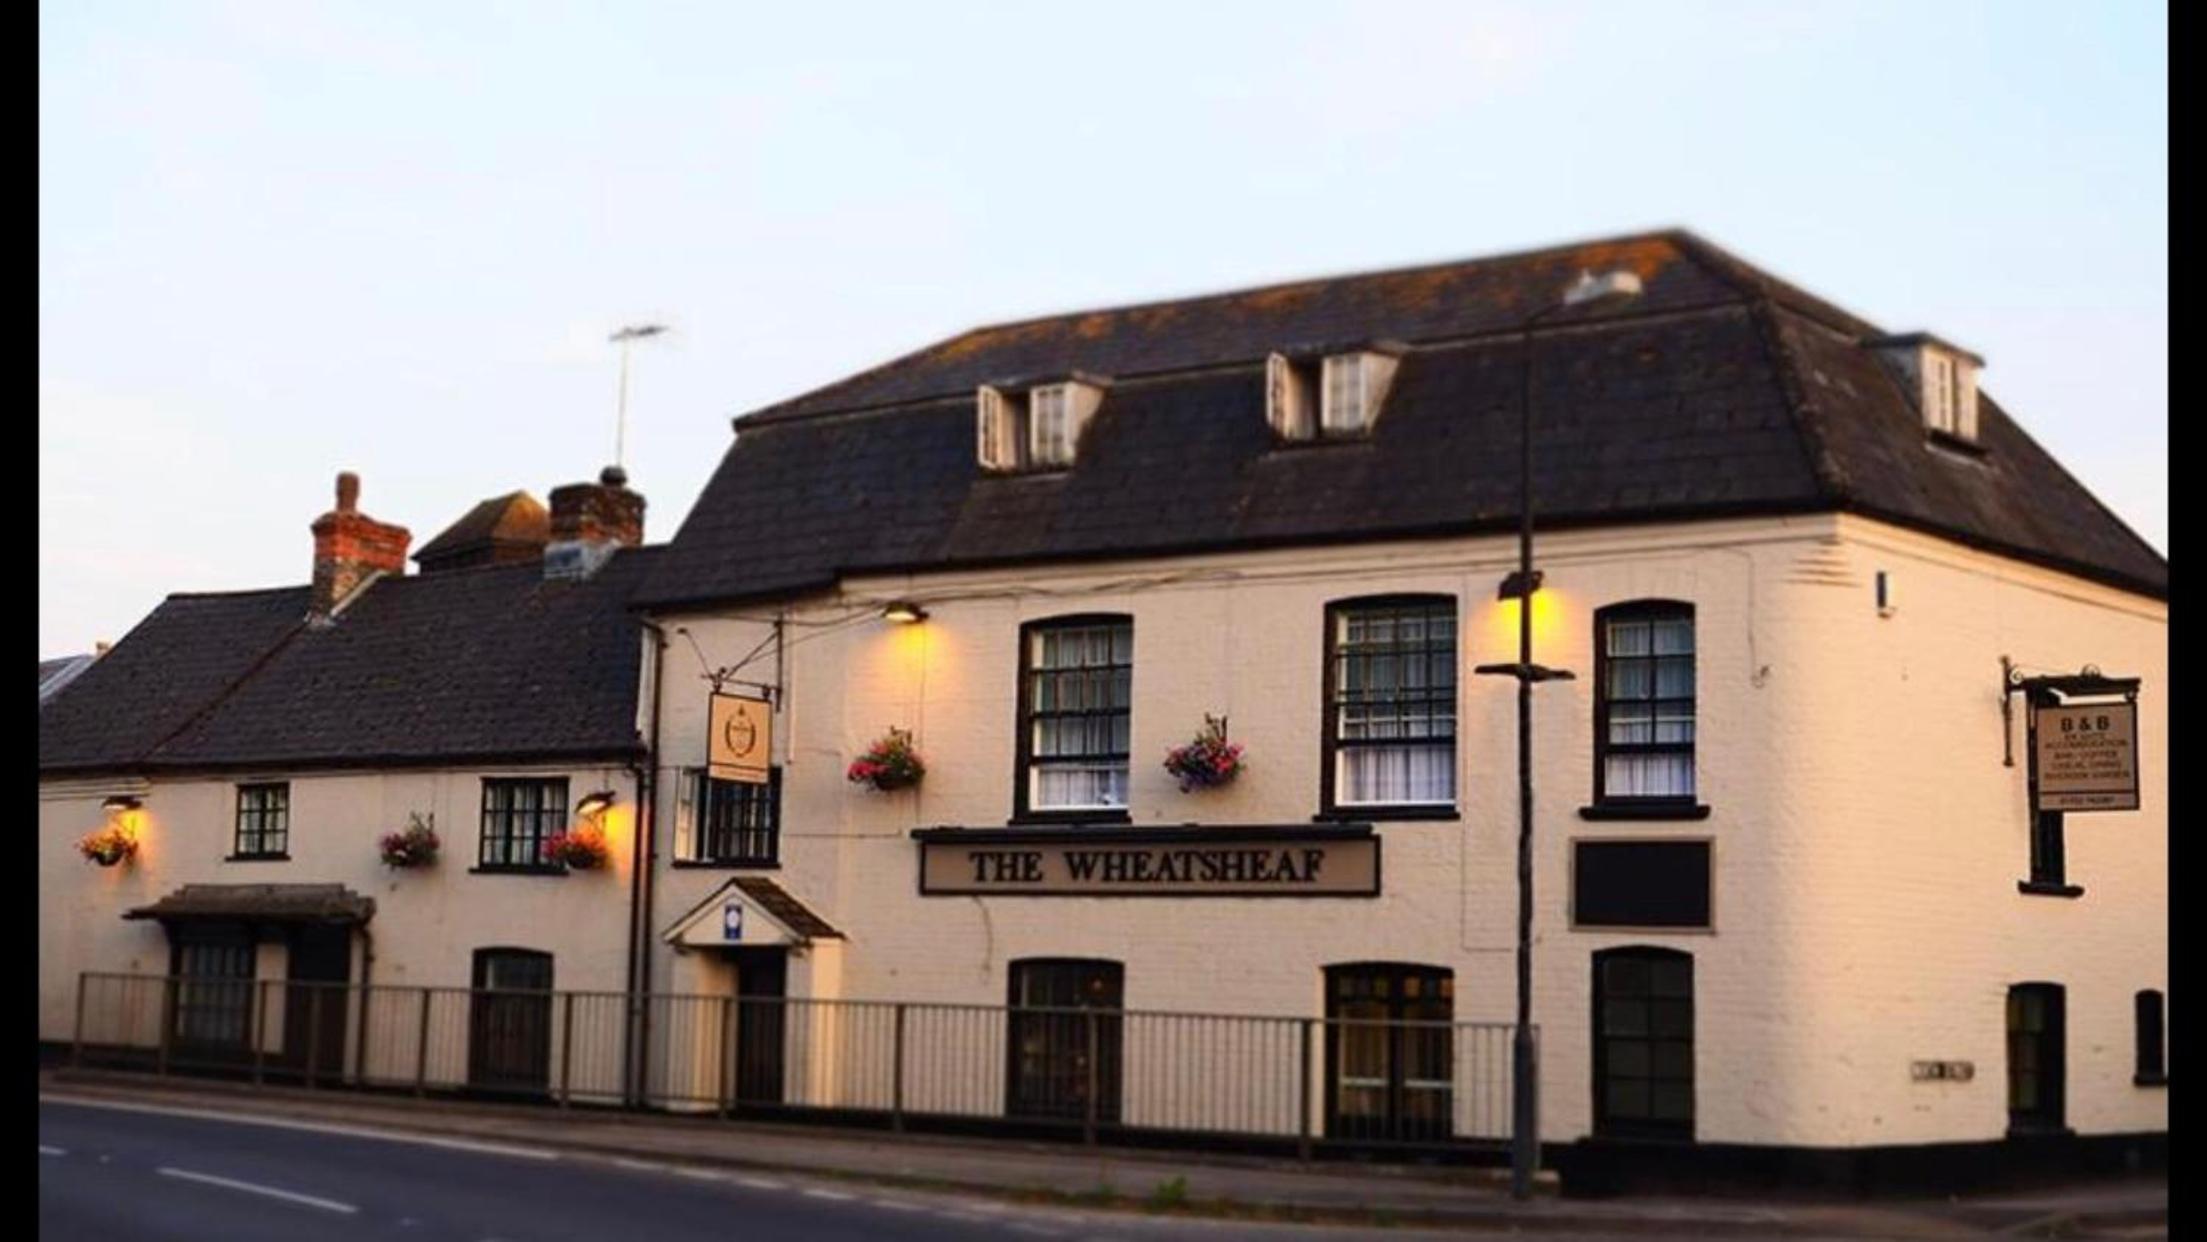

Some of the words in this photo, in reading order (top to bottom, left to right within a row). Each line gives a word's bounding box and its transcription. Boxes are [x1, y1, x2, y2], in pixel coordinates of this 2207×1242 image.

[2061, 717, 2073, 732] B
[2079, 716, 2091, 731] &
[2097, 715, 2109, 731] B
[970, 851, 1042, 883] THE
[1064, 849, 1325, 883] WHEATSHEAF
